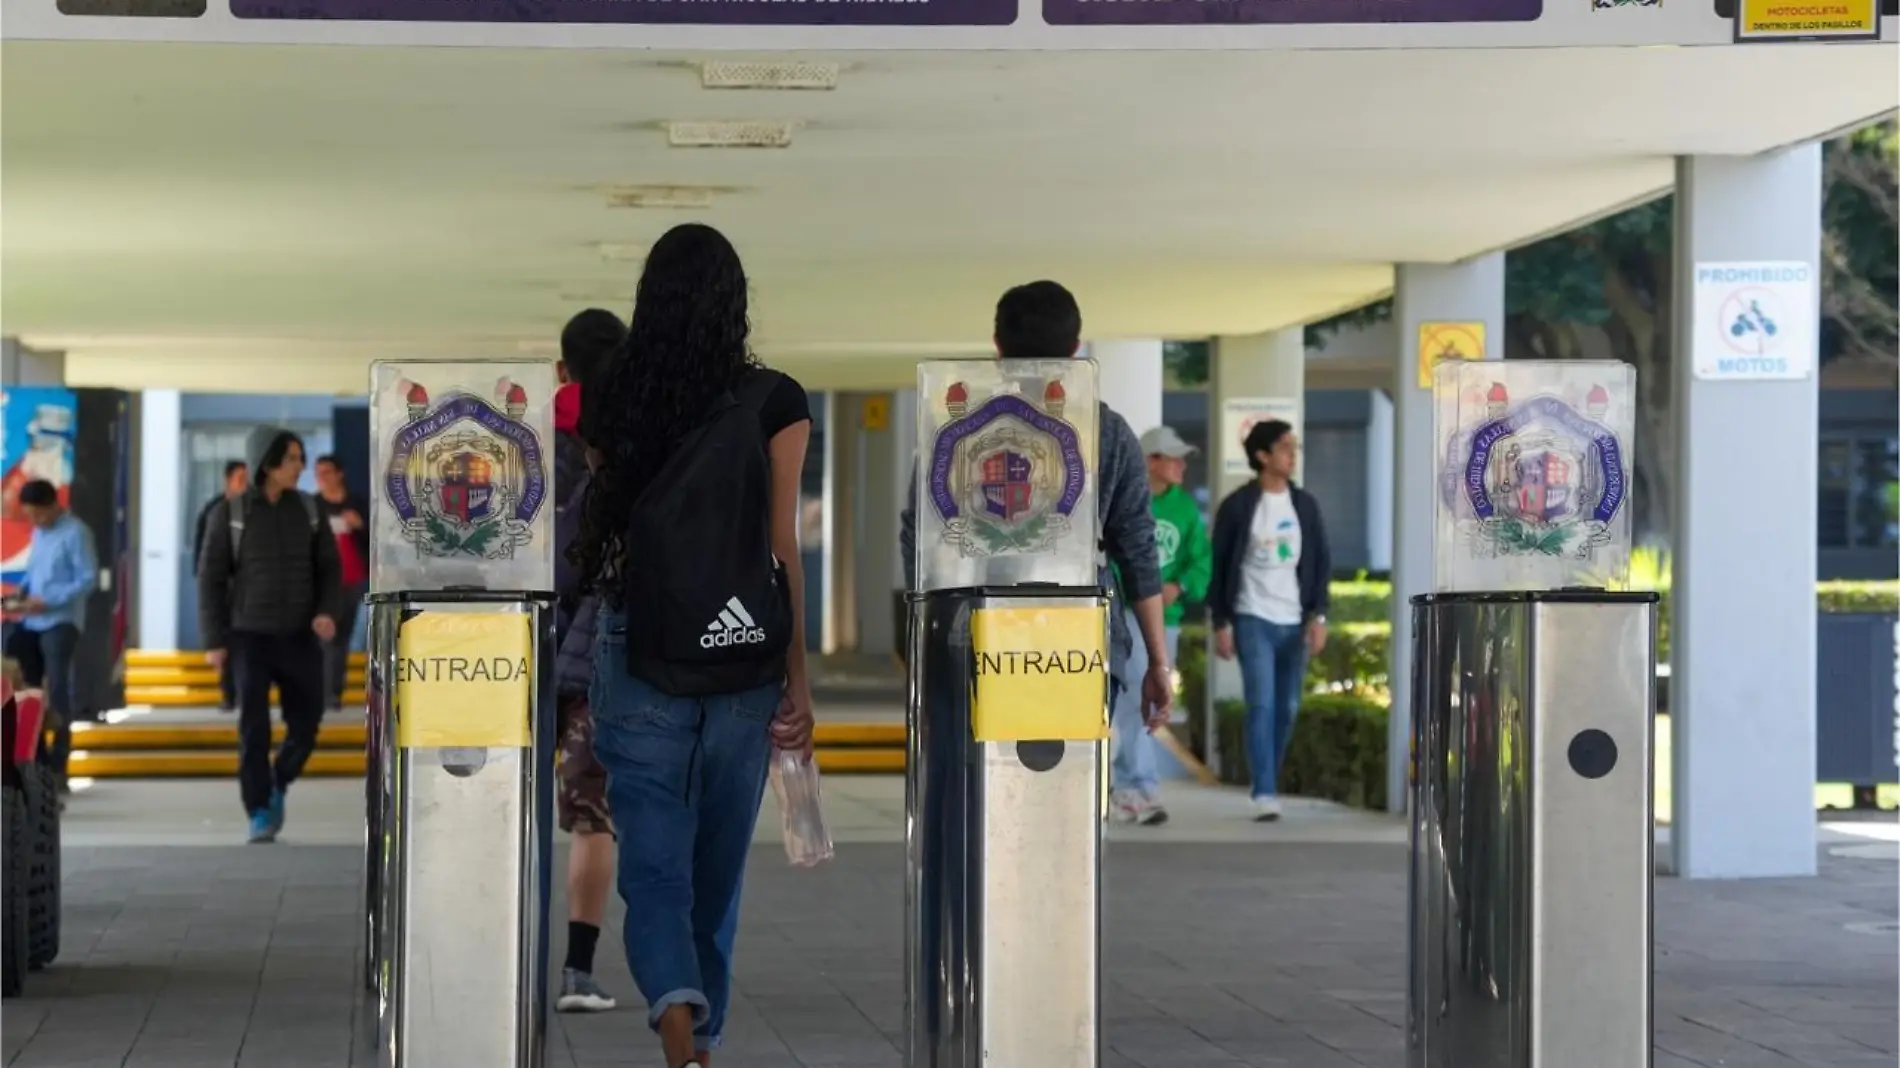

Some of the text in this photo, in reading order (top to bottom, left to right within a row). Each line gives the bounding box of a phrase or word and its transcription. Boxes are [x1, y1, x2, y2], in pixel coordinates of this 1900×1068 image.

[1767, 6, 1848, 16] MOTOCICLETAS
[1753, 21, 1788, 31] DENTRO
[1789, 21, 1801, 29] DE
[1803, 21, 1820, 29] LOS
[1698, 268, 1808, 283] PROHIBIDO
[1718, 358, 1788, 373] MOTOS
[700, 625, 766, 649] adidas
